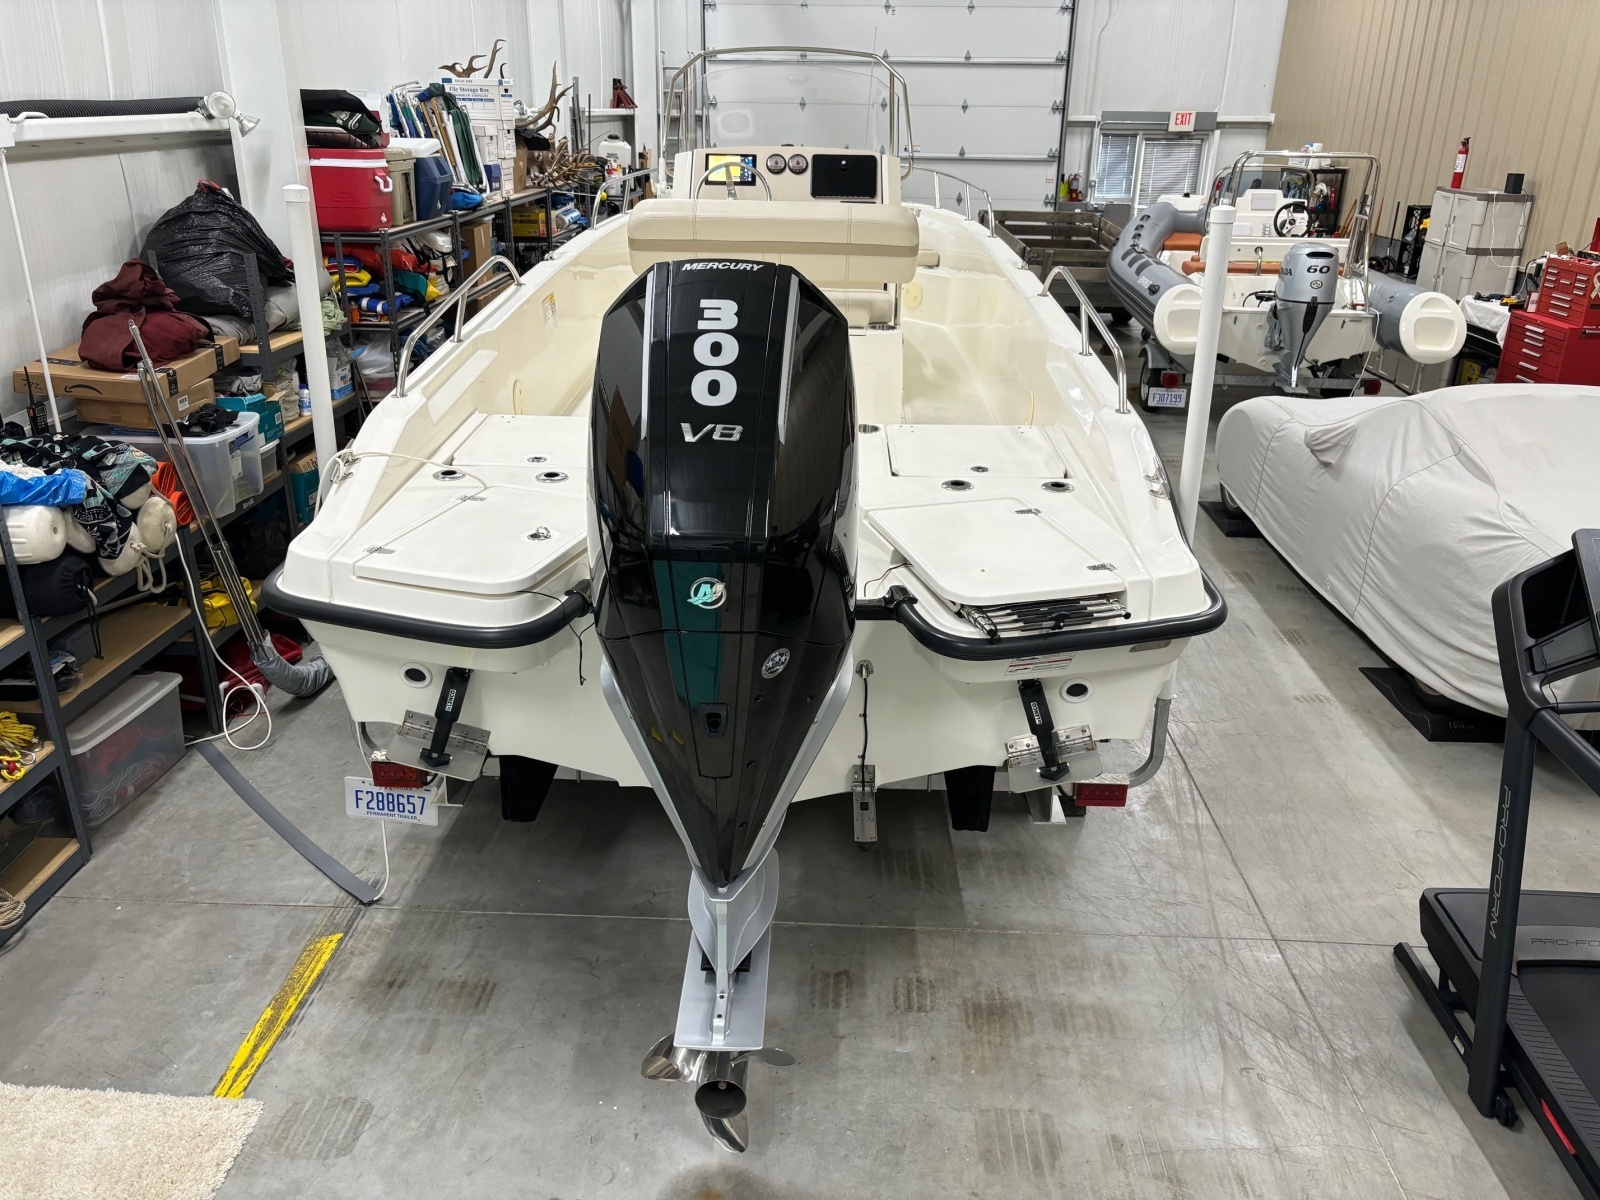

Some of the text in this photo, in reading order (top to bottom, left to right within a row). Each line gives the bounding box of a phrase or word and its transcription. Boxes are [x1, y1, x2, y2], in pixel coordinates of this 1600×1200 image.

[1174, 112, 1193, 126] EXIT
[682, 261, 765, 272] MERCURY
[1306, 264, 1331, 275] 60
[690, 299, 740, 407] 300
[1152, 392, 1183, 404] F307199
[680, 422, 744, 443] V8
[446, 689, 457, 707] LENCO
[1030, 702, 1041, 721] LENCO
[355, 789, 426, 816] F288657
[366, 810, 418, 821] PERMANENT TRAILER
[1489, 785, 1511, 940] PRO-FORM
[1530, 937, 1600, 947] PRO-FO
